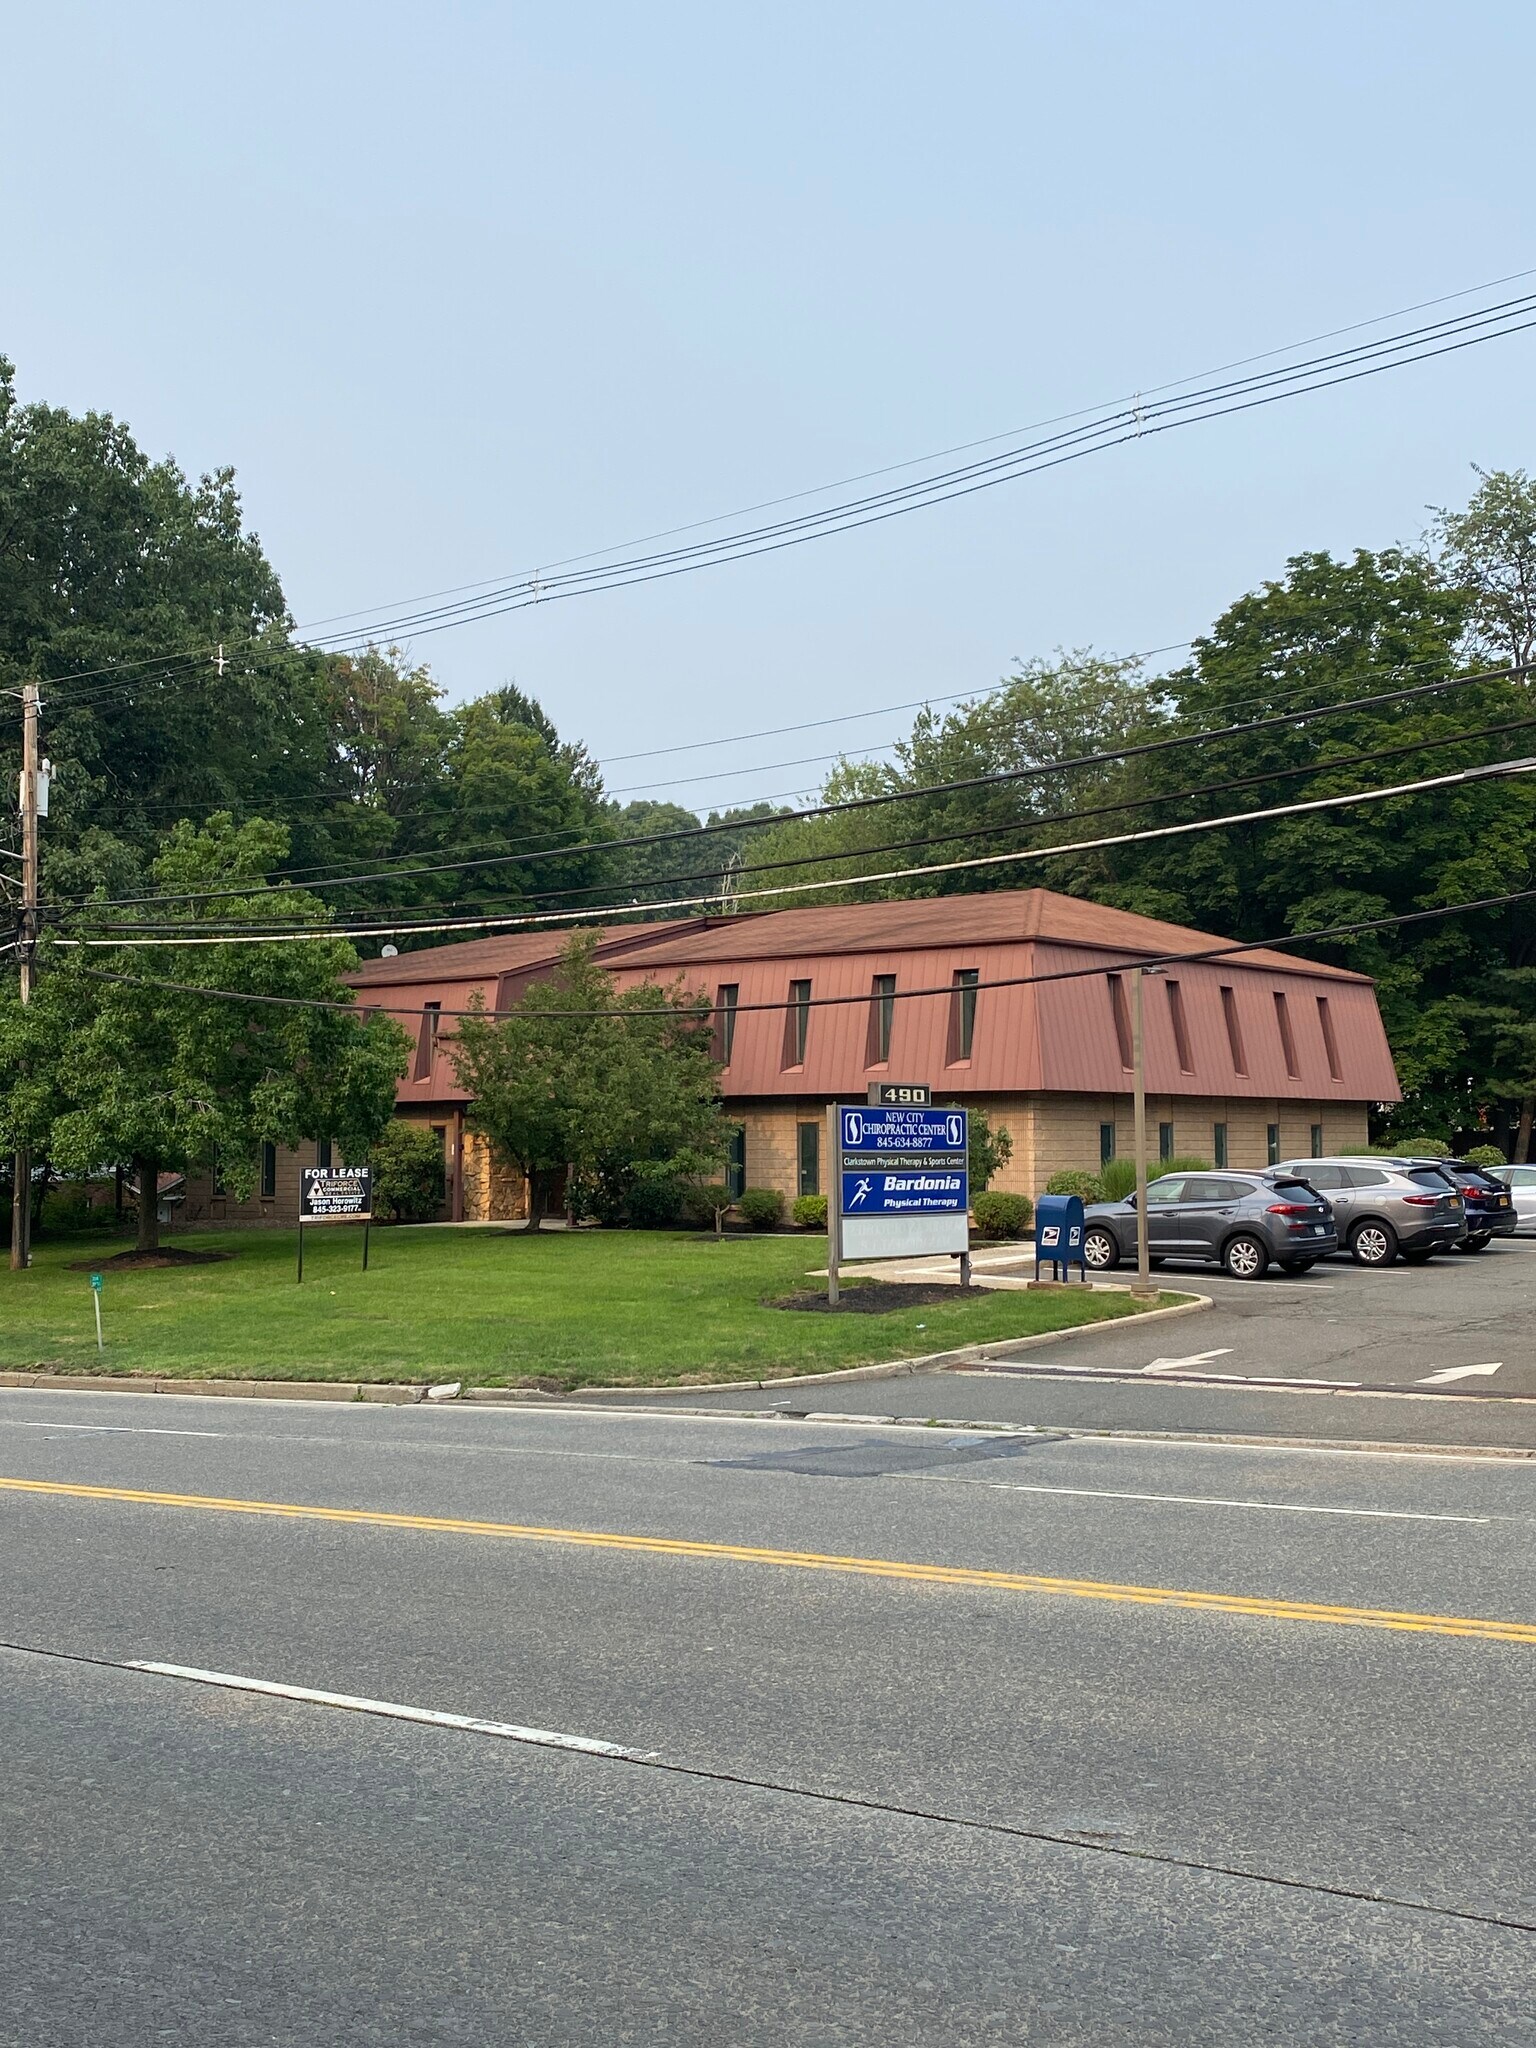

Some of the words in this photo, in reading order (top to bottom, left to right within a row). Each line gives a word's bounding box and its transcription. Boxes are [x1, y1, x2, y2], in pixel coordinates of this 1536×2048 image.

[884, 1088, 925, 1102] 490
[886, 1112, 905, 1123] NEW
[907, 1112, 924, 1123] CITY
[862, 1123, 918, 1135] CHIROPRACTIC
[918, 1125, 946, 1136] CENTER
[877, 1137, 932, 1148] 845-634-8877
[843, 1157, 876, 1166] Clarkstown
[876, 1157, 899, 1168] Physical
[900, 1158, 922, 1167] Therapy
[928, 1158, 946, 1167] Sports
[305, 1169, 328, 1178] FOR
[333, 1168, 368, 1178] LEASE
[884, 1176, 961, 1191] Bardonia
[884, 1198, 921, 1208] Physical
[922, 1198, 958, 1208] Therapy
[313, 1205, 358, 1213] 845-323-9177
